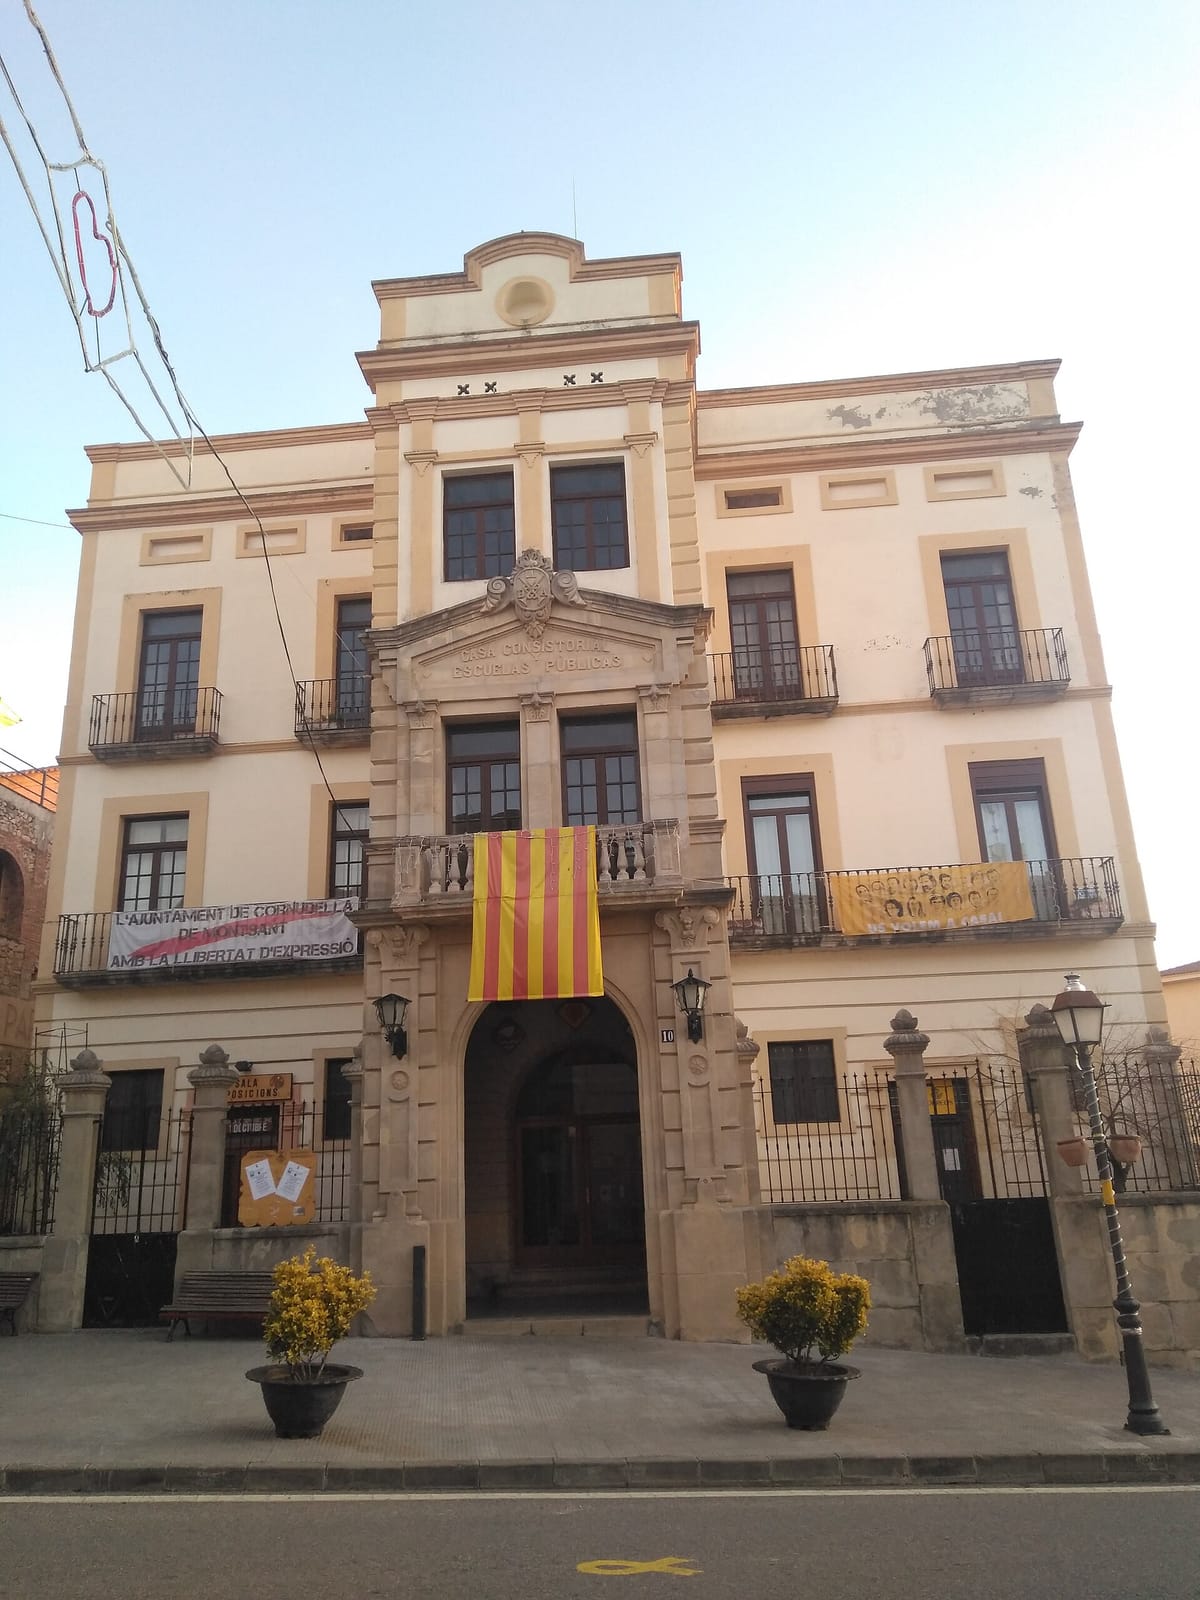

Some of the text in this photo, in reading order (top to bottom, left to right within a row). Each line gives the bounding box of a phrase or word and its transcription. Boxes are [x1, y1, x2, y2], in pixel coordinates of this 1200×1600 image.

[460, 639, 610, 662] CASA CONSISTORIAL
[452, 663, 529, 679] ESCUELAS
[116, 899, 354, 927] L'AJUNTAMENT DE CORNUDELLA
[178, 921, 288, 942] DE MONTSANT
[110, 937, 354, 969] AMB LA LLIBERTAT D'EXPRESSIÓ
[663, 1031, 673, 1042] 10
[234, 1078, 258, 1088] SALA
